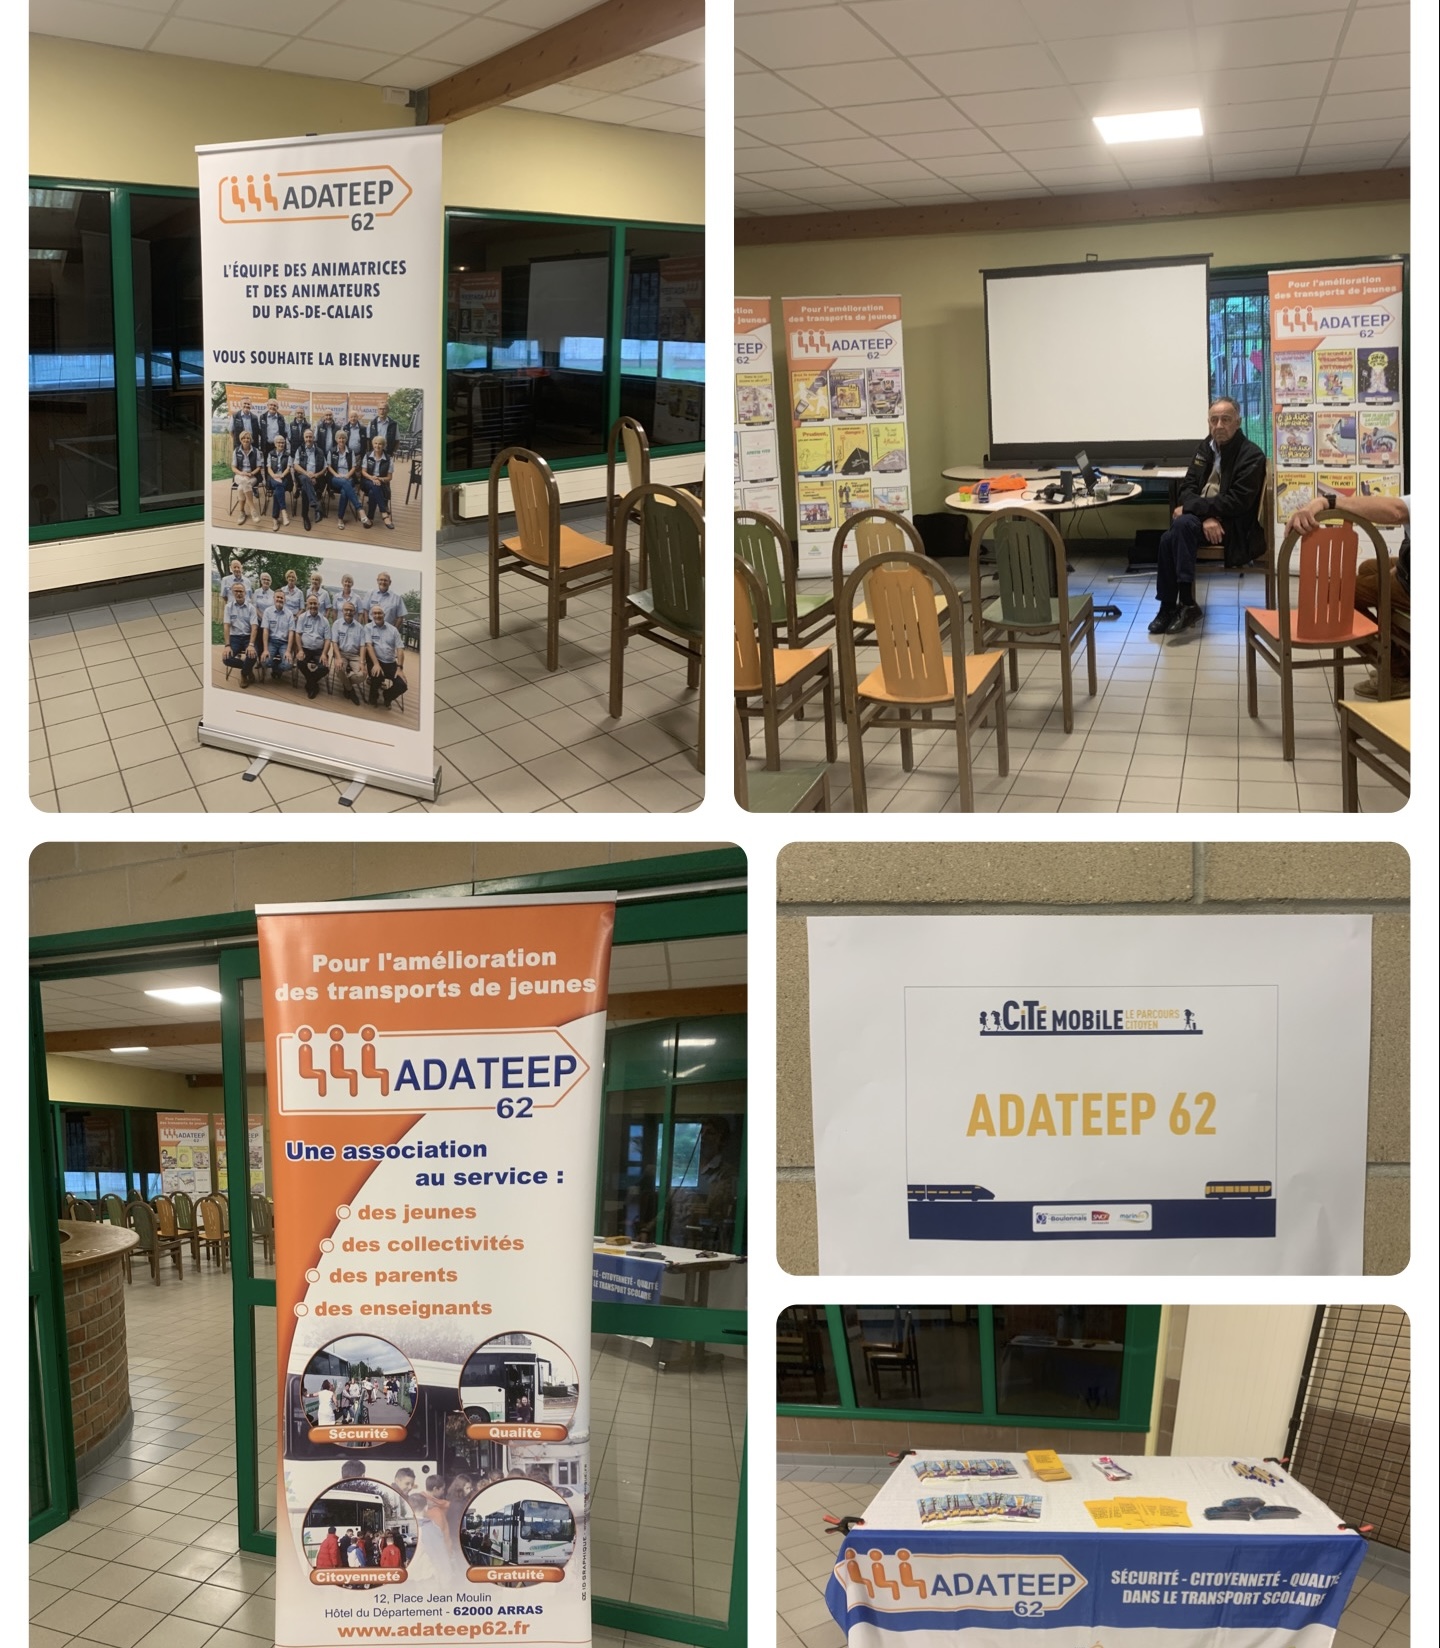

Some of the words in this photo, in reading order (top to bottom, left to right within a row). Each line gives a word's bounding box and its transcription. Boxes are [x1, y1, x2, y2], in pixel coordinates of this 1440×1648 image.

[282, 179, 394, 211] ADATEEP
[351, 212, 375, 232] 62
[284, 262, 307, 277] DES
[311, 260, 407, 276] ANIMATRICES
[245, 284, 259, 298] ET
[264, 284, 287, 298] DES
[291, 282, 381, 298] ANIMATEURS
[1274, 291, 1291, 300] des
[1294, 288, 1345, 299] transports
[1347, 287, 1361, 295] de
[1363, 285, 1397, 295] jeunes
[1288, 281, 1311, 289] Pour
[252, 305, 271, 319] DU
[275, 304, 373, 319] PAS-DE-CALAIS
[801, 305, 821, 314] Pour
[788, 316, 804, 324] des
[806, 314, 853, 323] transports
[855, 314, 867, 322] de
[868, 313, 897, 323] jeunes
[1319, 314, 1391, 330] ADATEEP
[1359, 329, 1375, 339] 62
[831, 338, 893, 352] ADATEEP
[212, 349, 246, 364] VOUS
[250, 350, 314, 366] SOUHAITE
[318, 352, 334, 366] LA
[339, 352, 420, 369] BIENVENUE
[736, 356, 750, 365] 62
[866, 352, 880, 360] 62
[312, 953, 370, 973] Pour
[378, 949, 557, 972] l'amélioration
[275, 983, 319, 1002] des
[327, 979, 461, 1003] transports
[469, 978, 501, 997] de
[508, 976, 597, 1001] jeunes
[1125, 1009, 1135, 1019] LE
[1136, 1008, 1181, 1019] PARCOURS
[1125, 1019, 1159, 1030] CITOYEN
[393, 1054, 578, 1092] ADATEEP
[496, 1096, 534, 1119] 62
[965, 1092, 1157, 1137] ADATEEP
[1168, 1091, 1217, 1136] 62
[286, 1141, 335, 1160] Une
[342, 1140, 488, 1160] association
[415, 1170, 445, 1186] au
[453, 1167, 548, 1186] service
[357, 1204, 397, 1221] des
[402, 1204, 477, 1224] jeunes
[342, 1236, 380, 1252] des
[387, 1234, 525, 1252] collectivités
[329, 1268, 368, 1283] des
[375, 1266, 458, 1287] parents
[314, 1301, 354, 1317] des
[359, 1299, 493, 1319] enseignants
[328, 1426, 389, 1440] Sécurité
[489, 1426, 542, 1441] Qualité
[315, 1569, 401, 1585] Citoyenneté
[487, 1568, 545, 1581] Gratuité
[1110, 1569, 1180, 1586] SÉCURITÉ
[1189, 1570, 1280, 1588] CITOYENNETÉ
[930, 1569, 1077, 1598] ADATEEP
[374, 1593, 391, 1606] 12,
[393, 1593, 423, 1603] Place
[426, 1593, 454, 1603] Jean
[456, 1592, 492, 1603] Moulin
[1122, 1587, 1161, 1604] DANS
[1163, 1589, 1179, 1605] LE
[1181, 1589, 1260, 1606] TRANSPORT
[325, 1607, 353, 1619] Hôtel
[356, 1607, 370, 1618] du
[373, 1606, 443, 1620] Département
[453, 1606, 494, 1616] 62000
[497, 1604, 544, 1616] ARRAS
[1013, 1600, 1045, 1617] 62
[337, 1620, 531, 1639] www.adateep62.fr
